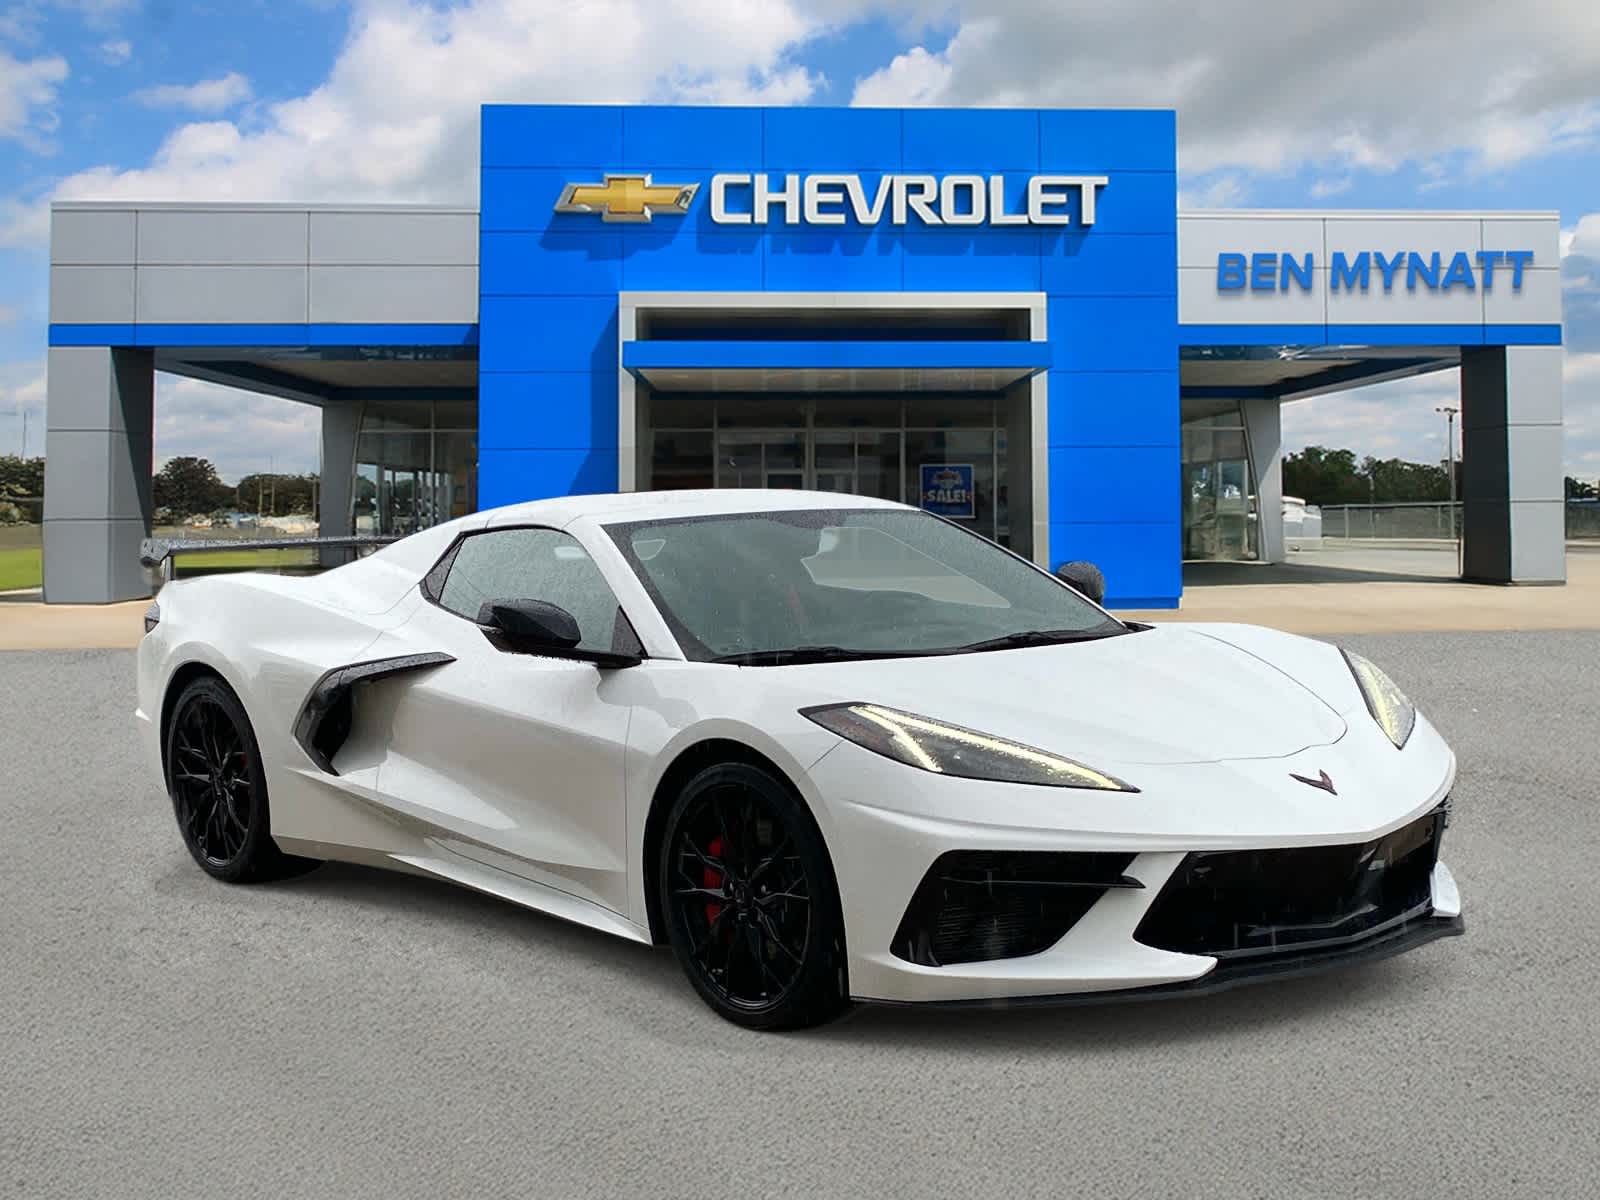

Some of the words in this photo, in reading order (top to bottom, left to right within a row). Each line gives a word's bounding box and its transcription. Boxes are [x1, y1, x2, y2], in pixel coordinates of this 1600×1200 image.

[710, 174, 1109, 226] CHEVROLET
[1217, 252, 1314, 290] BEN
[1330, 250, 1534, 290] MYNATT
[927, 489, 966, 503] SALE!
